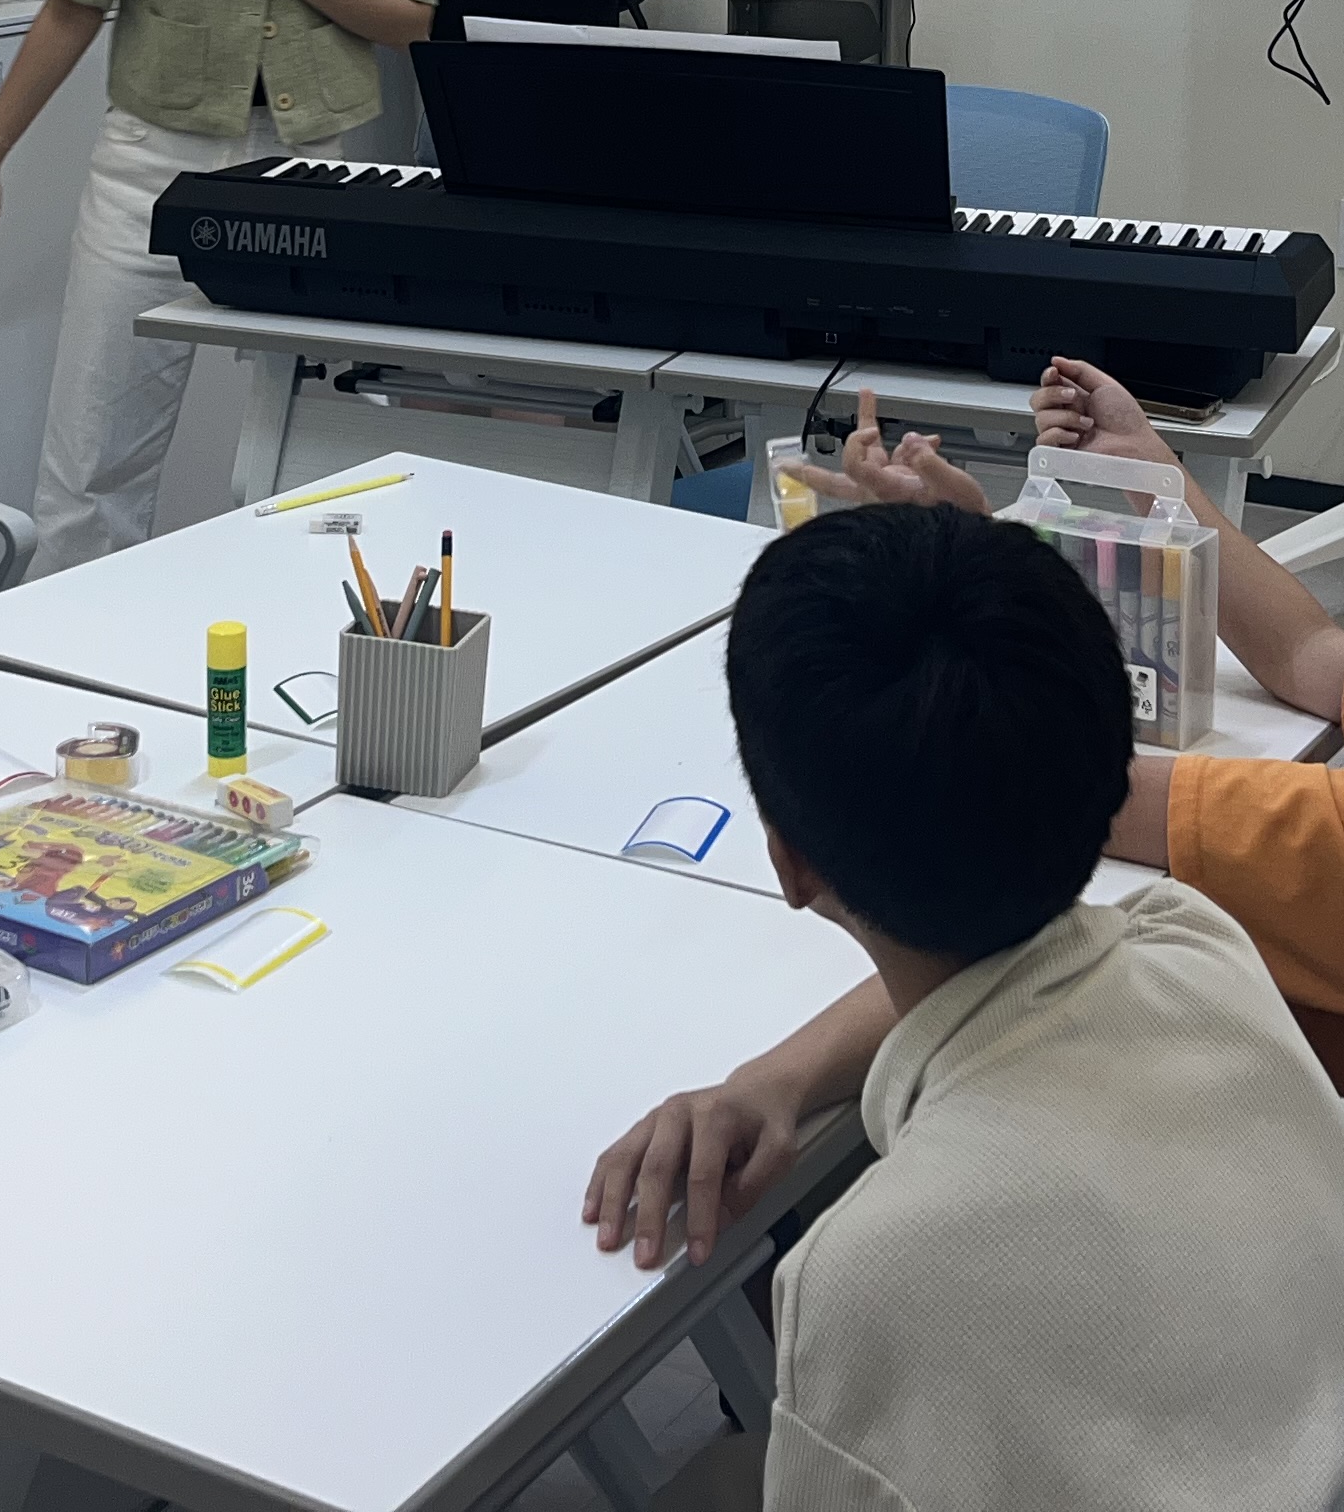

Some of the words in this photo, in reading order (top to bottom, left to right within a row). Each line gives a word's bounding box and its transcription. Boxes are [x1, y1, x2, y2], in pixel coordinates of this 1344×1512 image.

[224, 220, 327, 259] YAMAHA
[211, 688, 241, 701] Glue
[210, 699, 241, 712] Stick
[242, 872, 256, 896] 36
